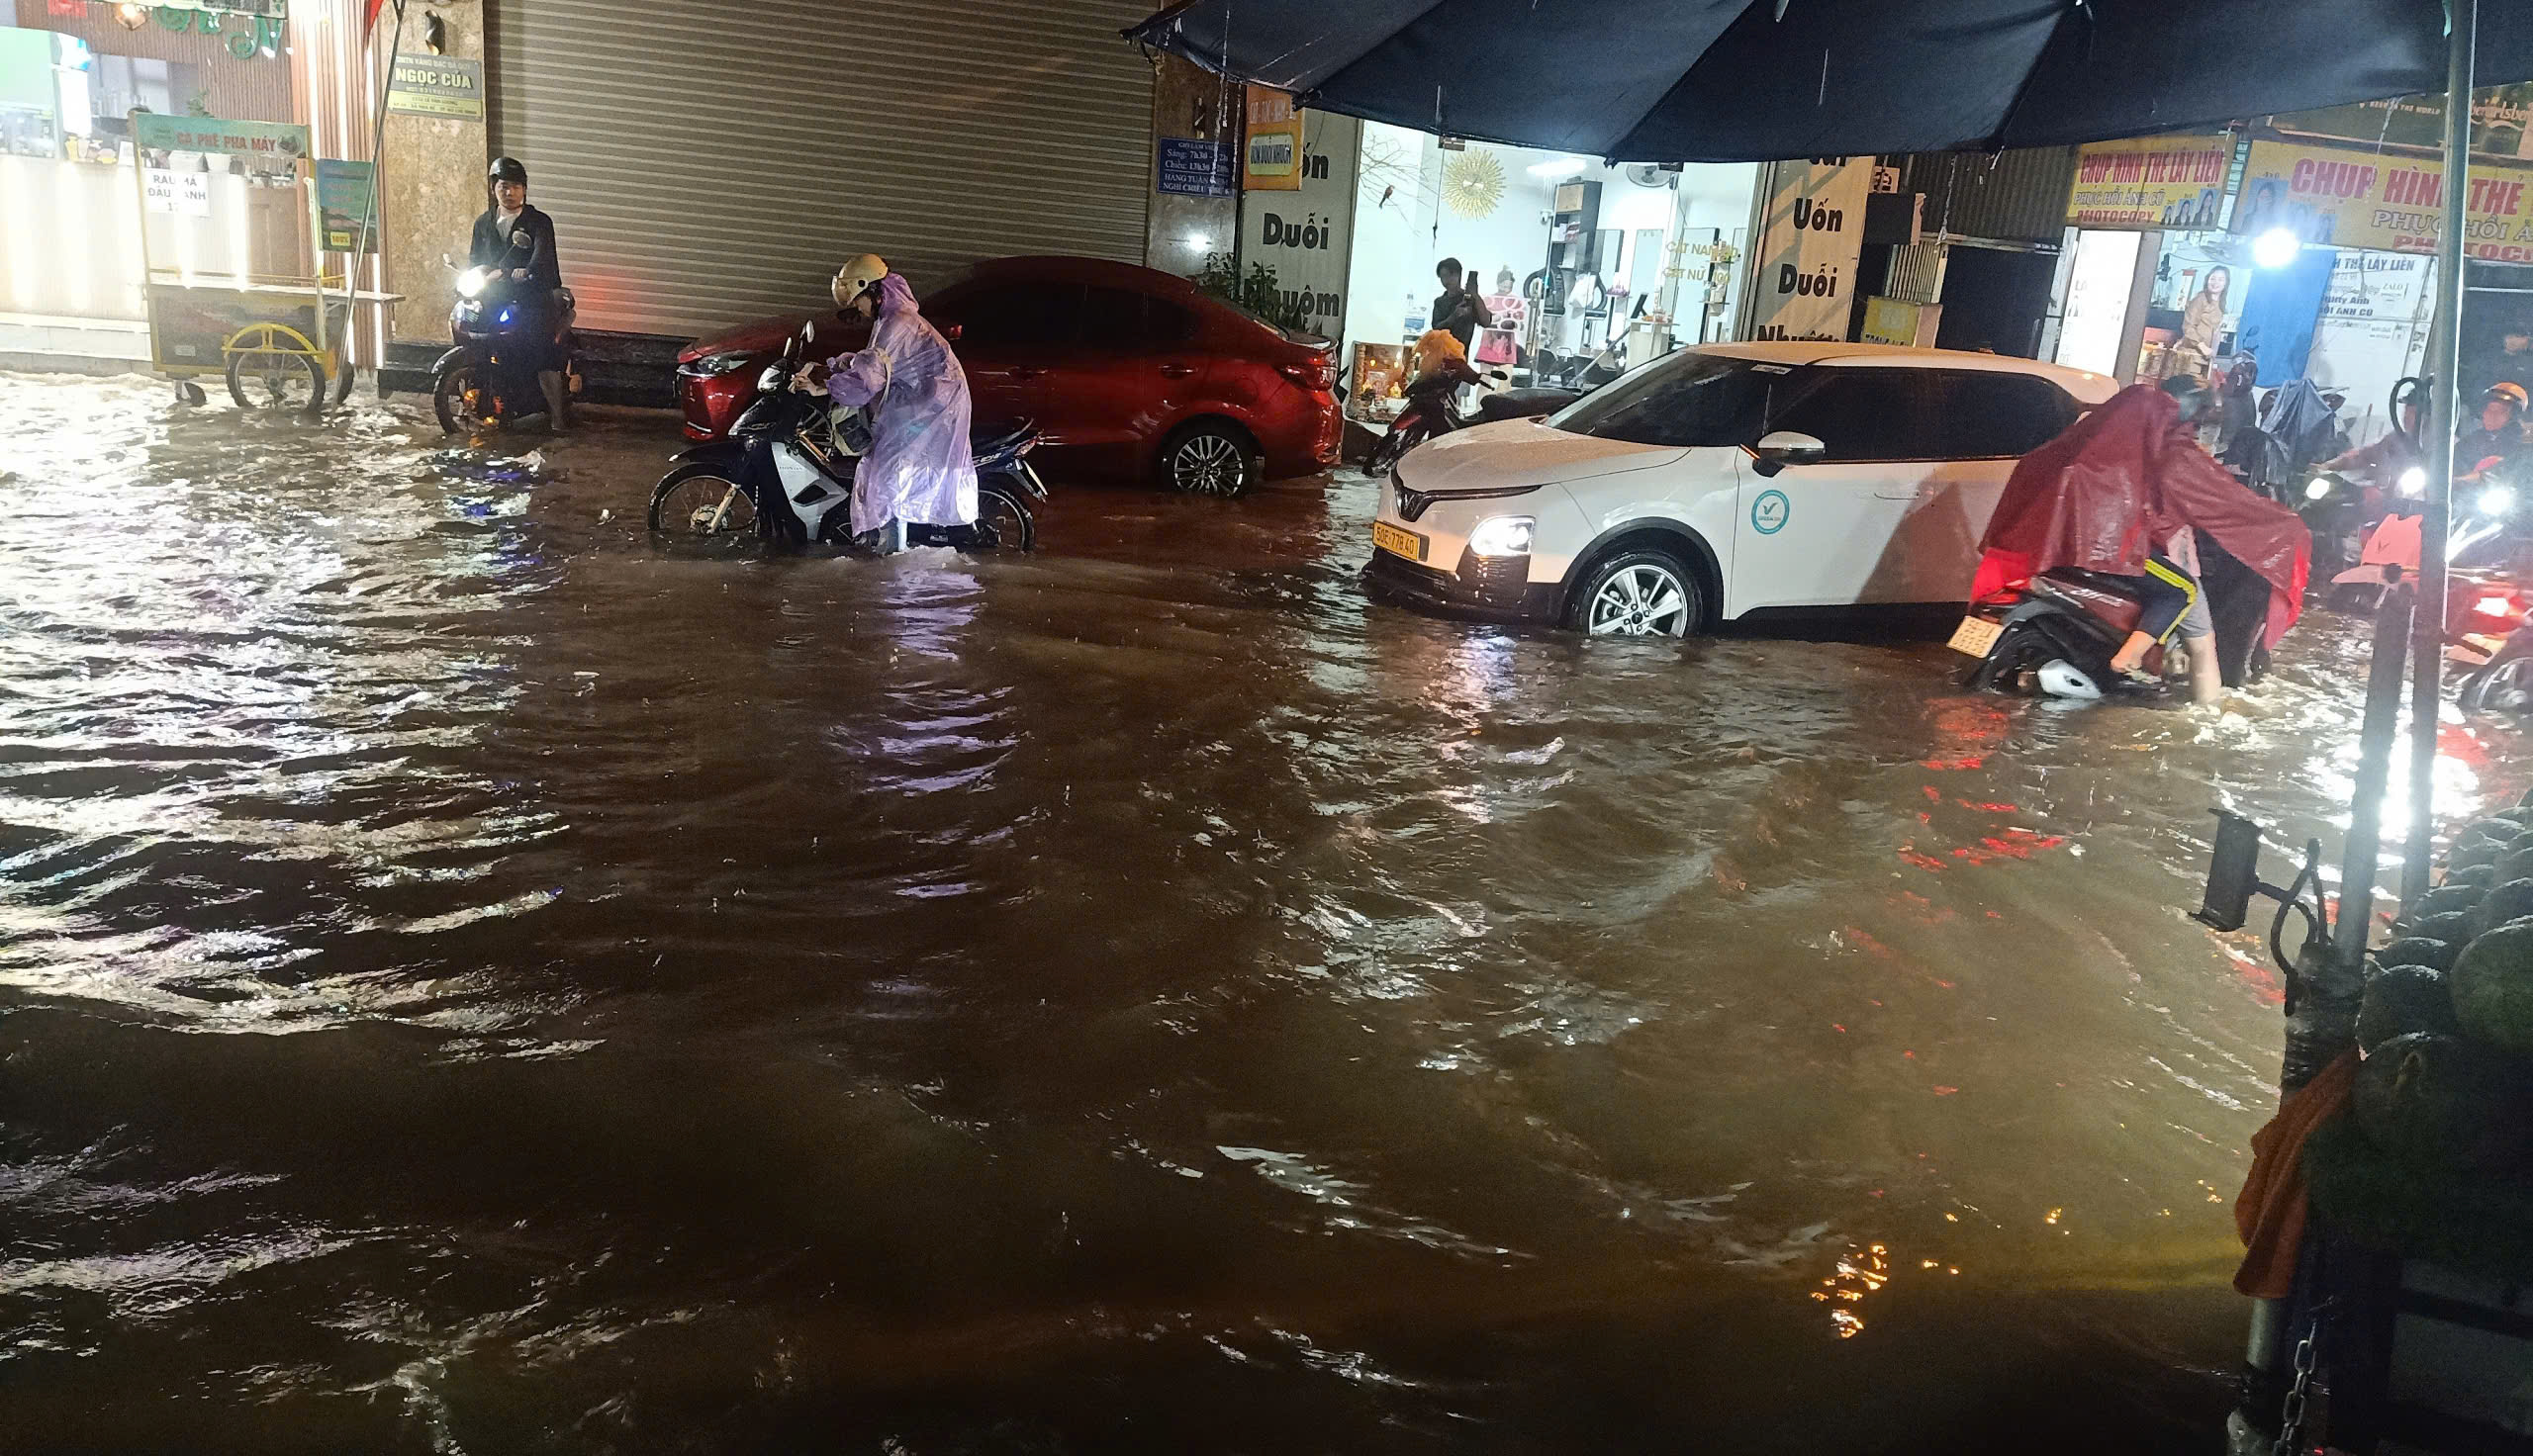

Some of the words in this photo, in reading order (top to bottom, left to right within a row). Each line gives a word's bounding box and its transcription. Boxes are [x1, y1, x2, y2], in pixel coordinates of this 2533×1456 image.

[395, 68, 437, 87] NGỌC
[250, 135, 277, 151] MÁY
[1302, 141, 1329, 180] ốn
[2383, 165, 2441, 209] HÌN
[1263, 212, 1329, 249] Duỗi
[1794, 198, 1843, 231] Uốn
[1778, 263, 1837, 298] Duỗi
